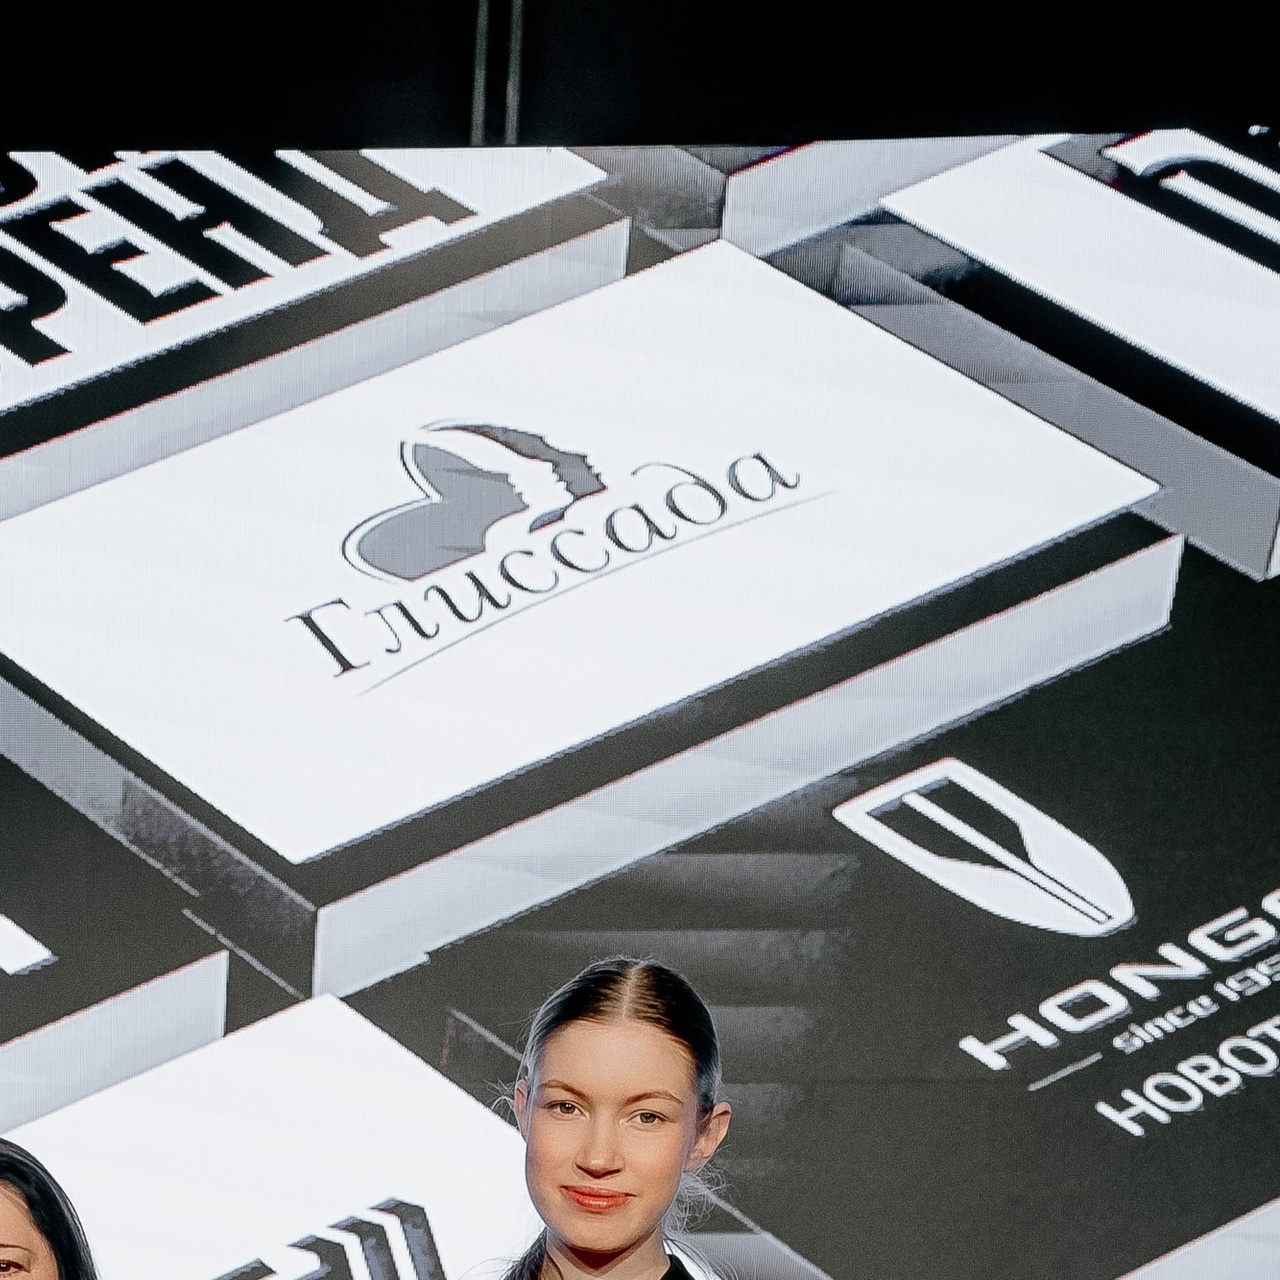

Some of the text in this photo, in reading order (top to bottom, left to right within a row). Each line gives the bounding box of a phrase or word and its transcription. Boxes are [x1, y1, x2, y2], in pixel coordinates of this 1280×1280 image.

[283, 452, 801, 677] Глиссада
[959, 887, 1280, 1071] HONG
[1112, 994, 1220, 1055] since
